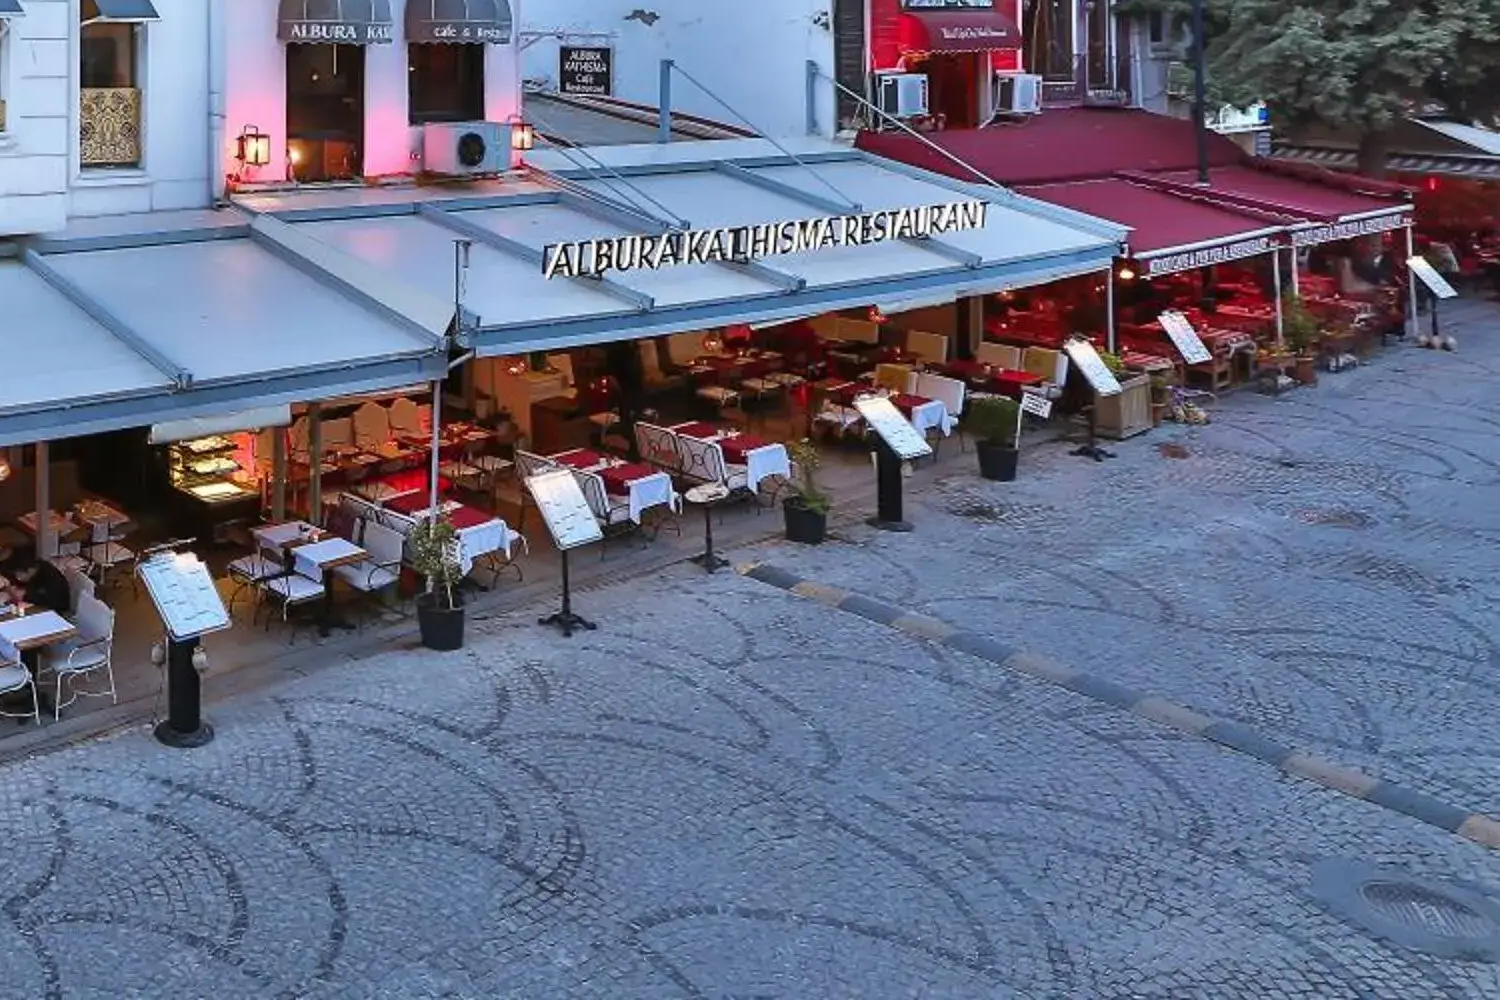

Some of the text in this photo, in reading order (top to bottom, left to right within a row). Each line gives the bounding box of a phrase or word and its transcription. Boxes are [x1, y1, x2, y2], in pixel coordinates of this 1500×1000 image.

[291, 23, 357, 39] ALBURA
[544, 201, 990, 280] ALBURA KATHISMA RESTAURANT
